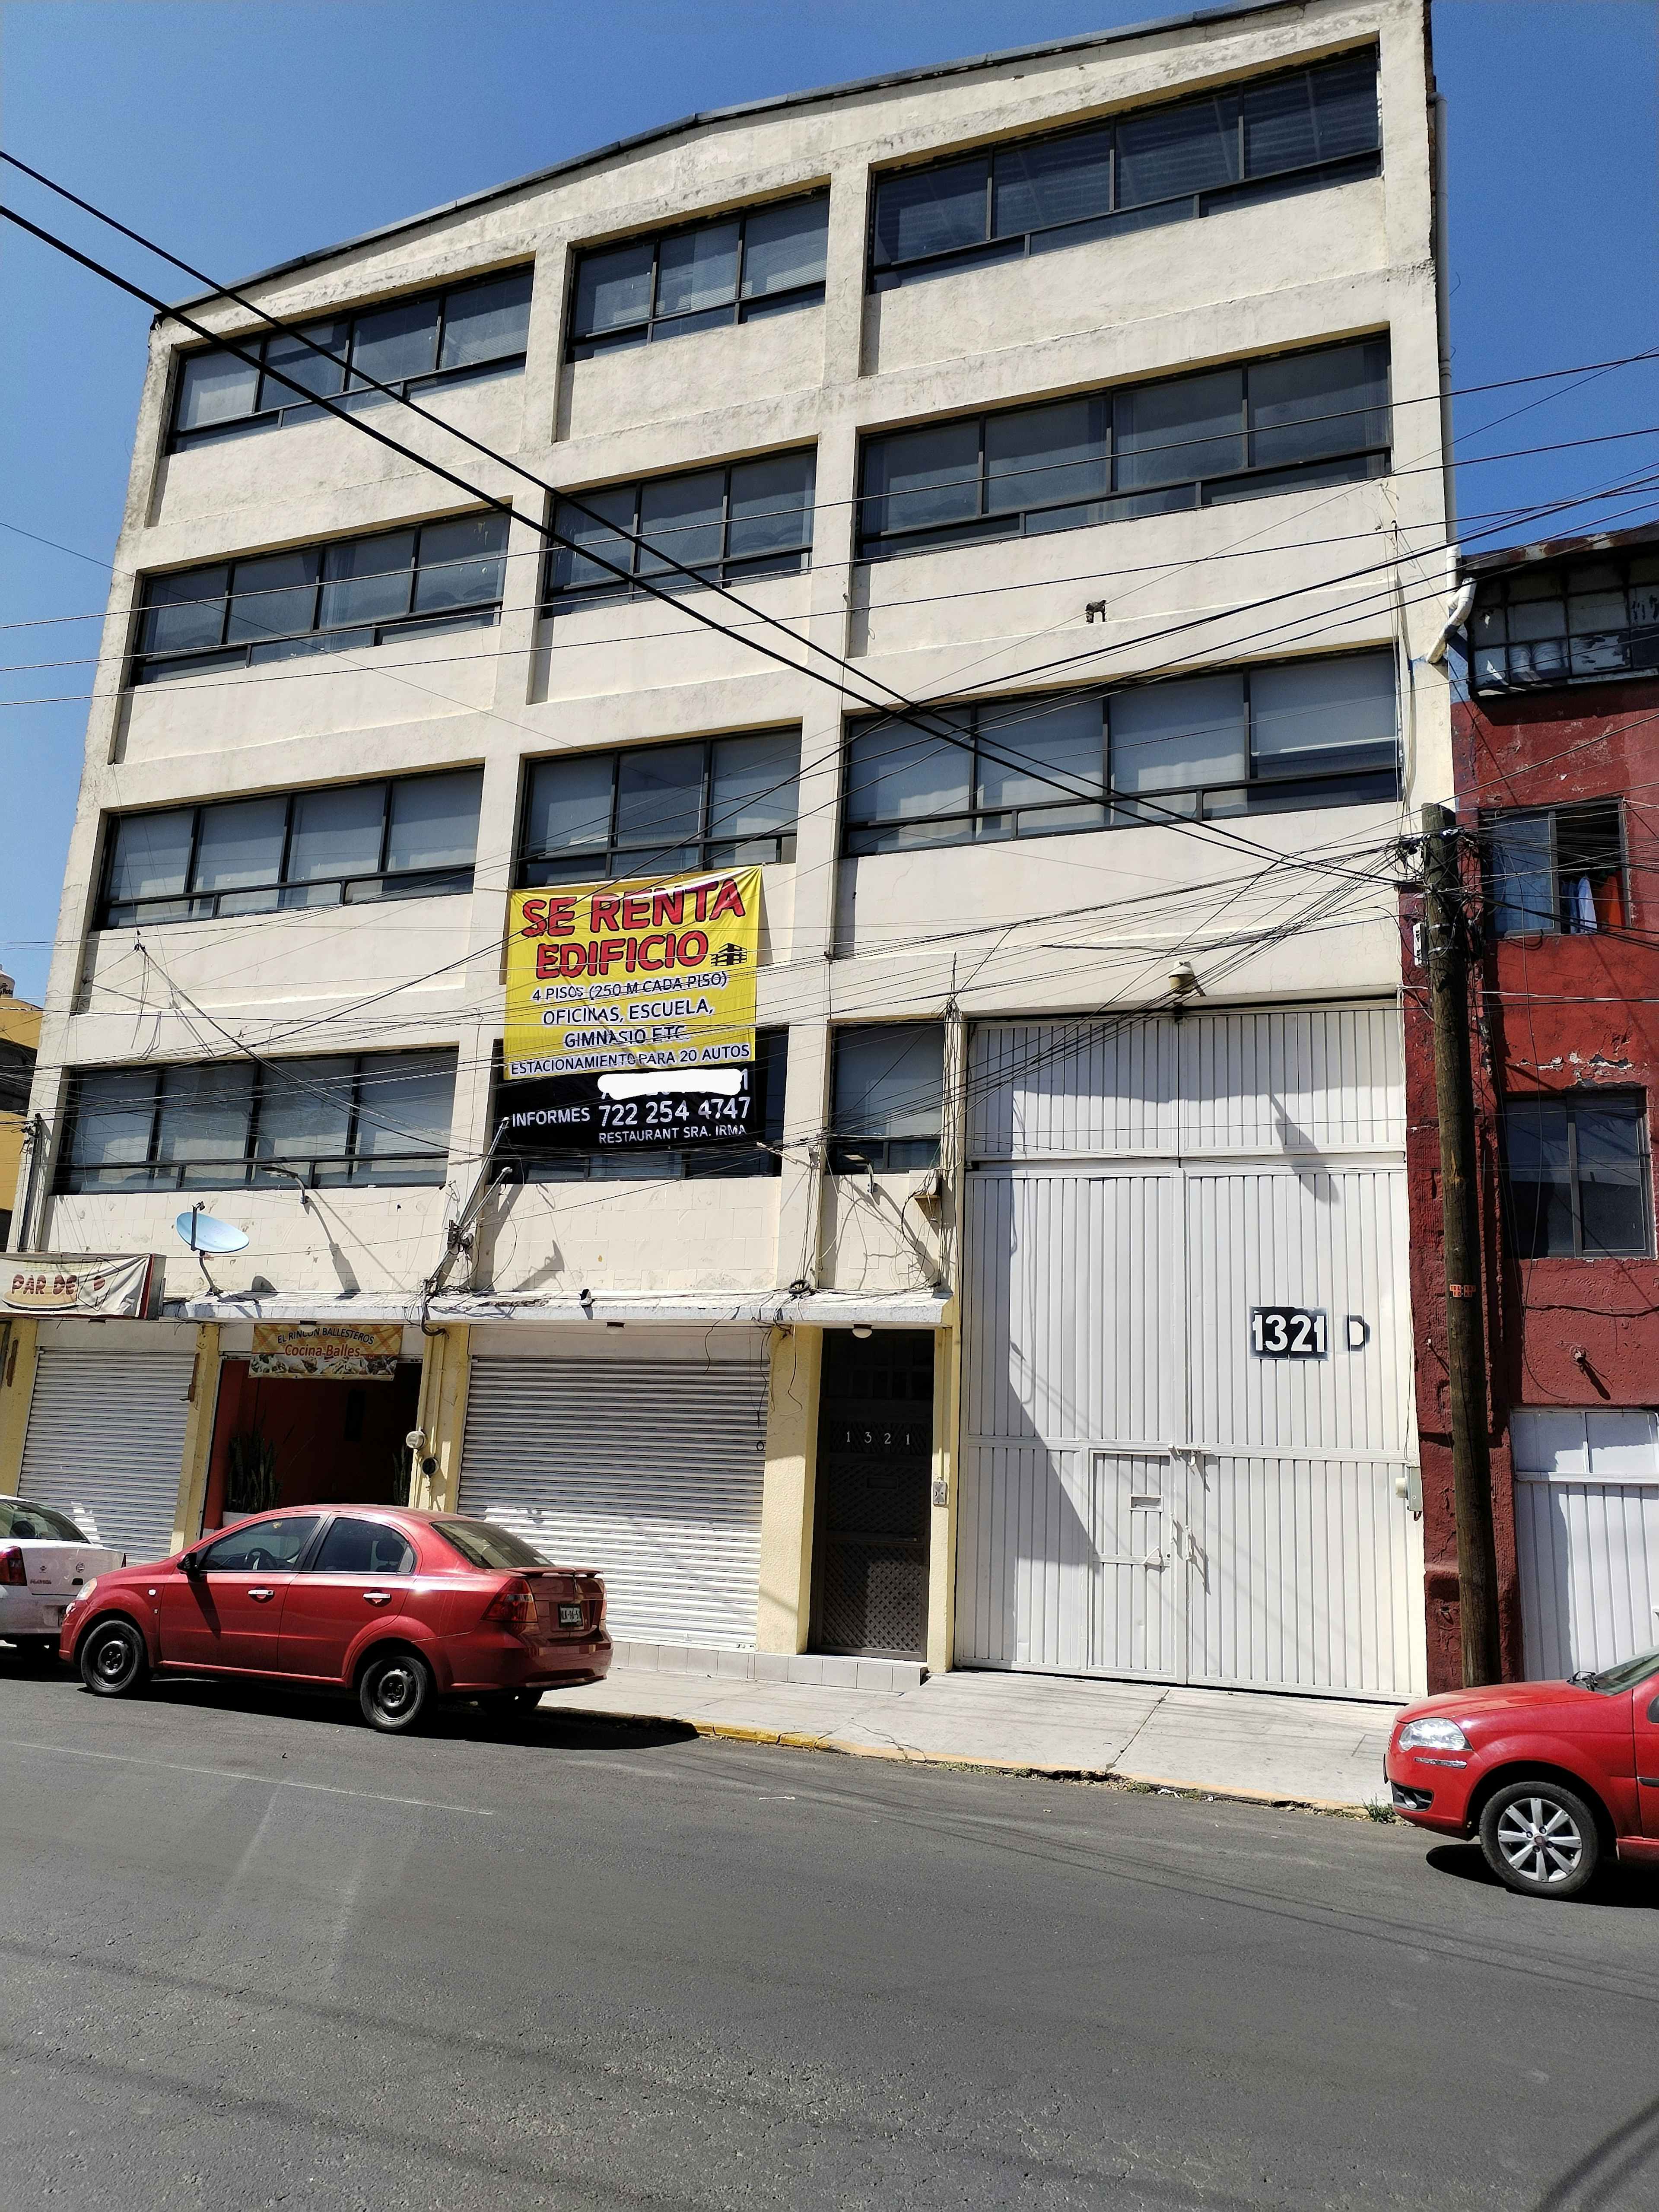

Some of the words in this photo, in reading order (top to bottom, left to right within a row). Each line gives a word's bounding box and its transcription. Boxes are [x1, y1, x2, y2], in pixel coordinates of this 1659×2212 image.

[521, 896, 577, 937] SE
[590, 878, 745, 933] RENTA
[536, 930, 709, 979] EDIFICIO
[532, 989, 541, 1001] 4
[546, 986, 584, 1000] PISOS
[589, 984, 621, 1000] (250
[627, 982, 638, 995] M
[643, 978, 681, 993] CADA
[687, 972, 727, 989] PISO)
[543, 1006, 624, 1024] OFICINAS,
[629, 998, 713, 1019] ESCUELA,
[565, 1029, 646, 1048] GIMNASIO
[511, 1053, 636, 1074] ESTACIONAMIENTO
[639, 1051, 675, 1065] PARA
[680, 1050, 697, 1062] 20
[702, 1045, 749, 1060] AUTOS
[512, 1107, 590, 1128] INFORMES
[598, 1103, 638, 1127] 722
[645, 1100, 690, 1124] 254
[698, 1096, 751, 1119] 4747
[599, 1127, 680, 1144] RESTAURANT
[683, 1126, 712, 1138] SRA.
[715, 1125, 747, 1136] IRMA
[11, 1274, 47, 1294] PAR
[53, 1274, 77, 1295] DE
[277, 1334, 287, 1344] EL
[322, 1327, 375, 1344] BALLESTEROS
[1252, 1314, 1325, 1352] 1321
[285, 1344, 322, 1356] Cocina
[326, 1344, 360, 1357] Balles
[846, 1431, 910, 1445] 1321
